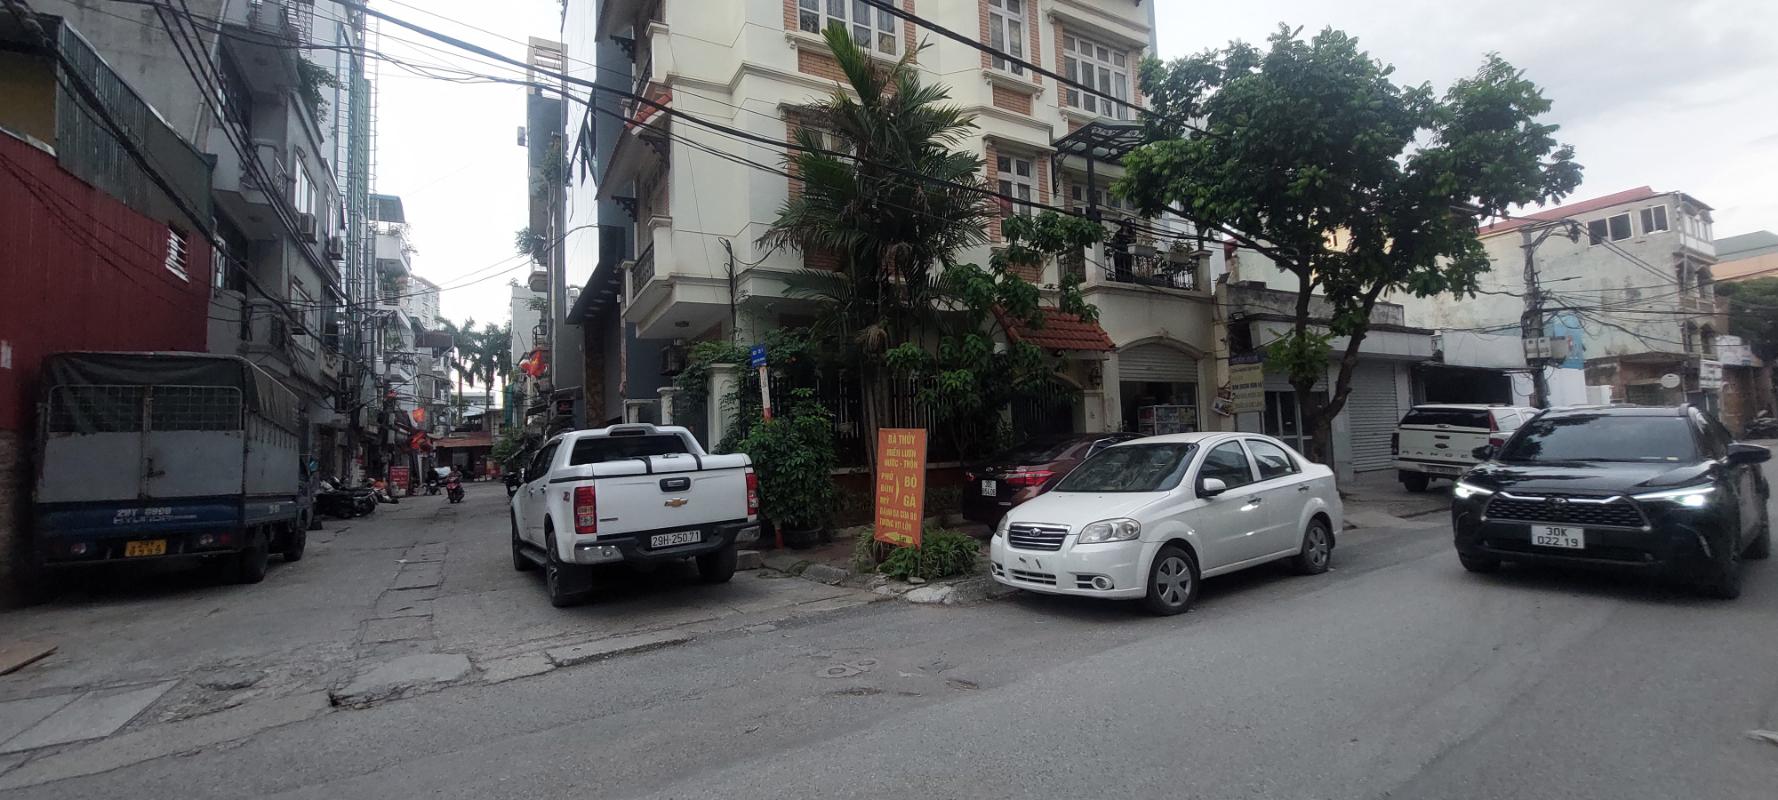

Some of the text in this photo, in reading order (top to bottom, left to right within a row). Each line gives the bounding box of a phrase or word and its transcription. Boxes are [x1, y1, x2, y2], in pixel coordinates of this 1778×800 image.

[1402, 450, 1469, 458] RANGE
[904, 473, 917, 488] BÒ
[903, 493, 916, 508] GÀ
[1546, 527, 1568, 537] 30K
[652, 531, 700, 547] 29H-250.71
[1537, 536, 1578, 547] 022.19
